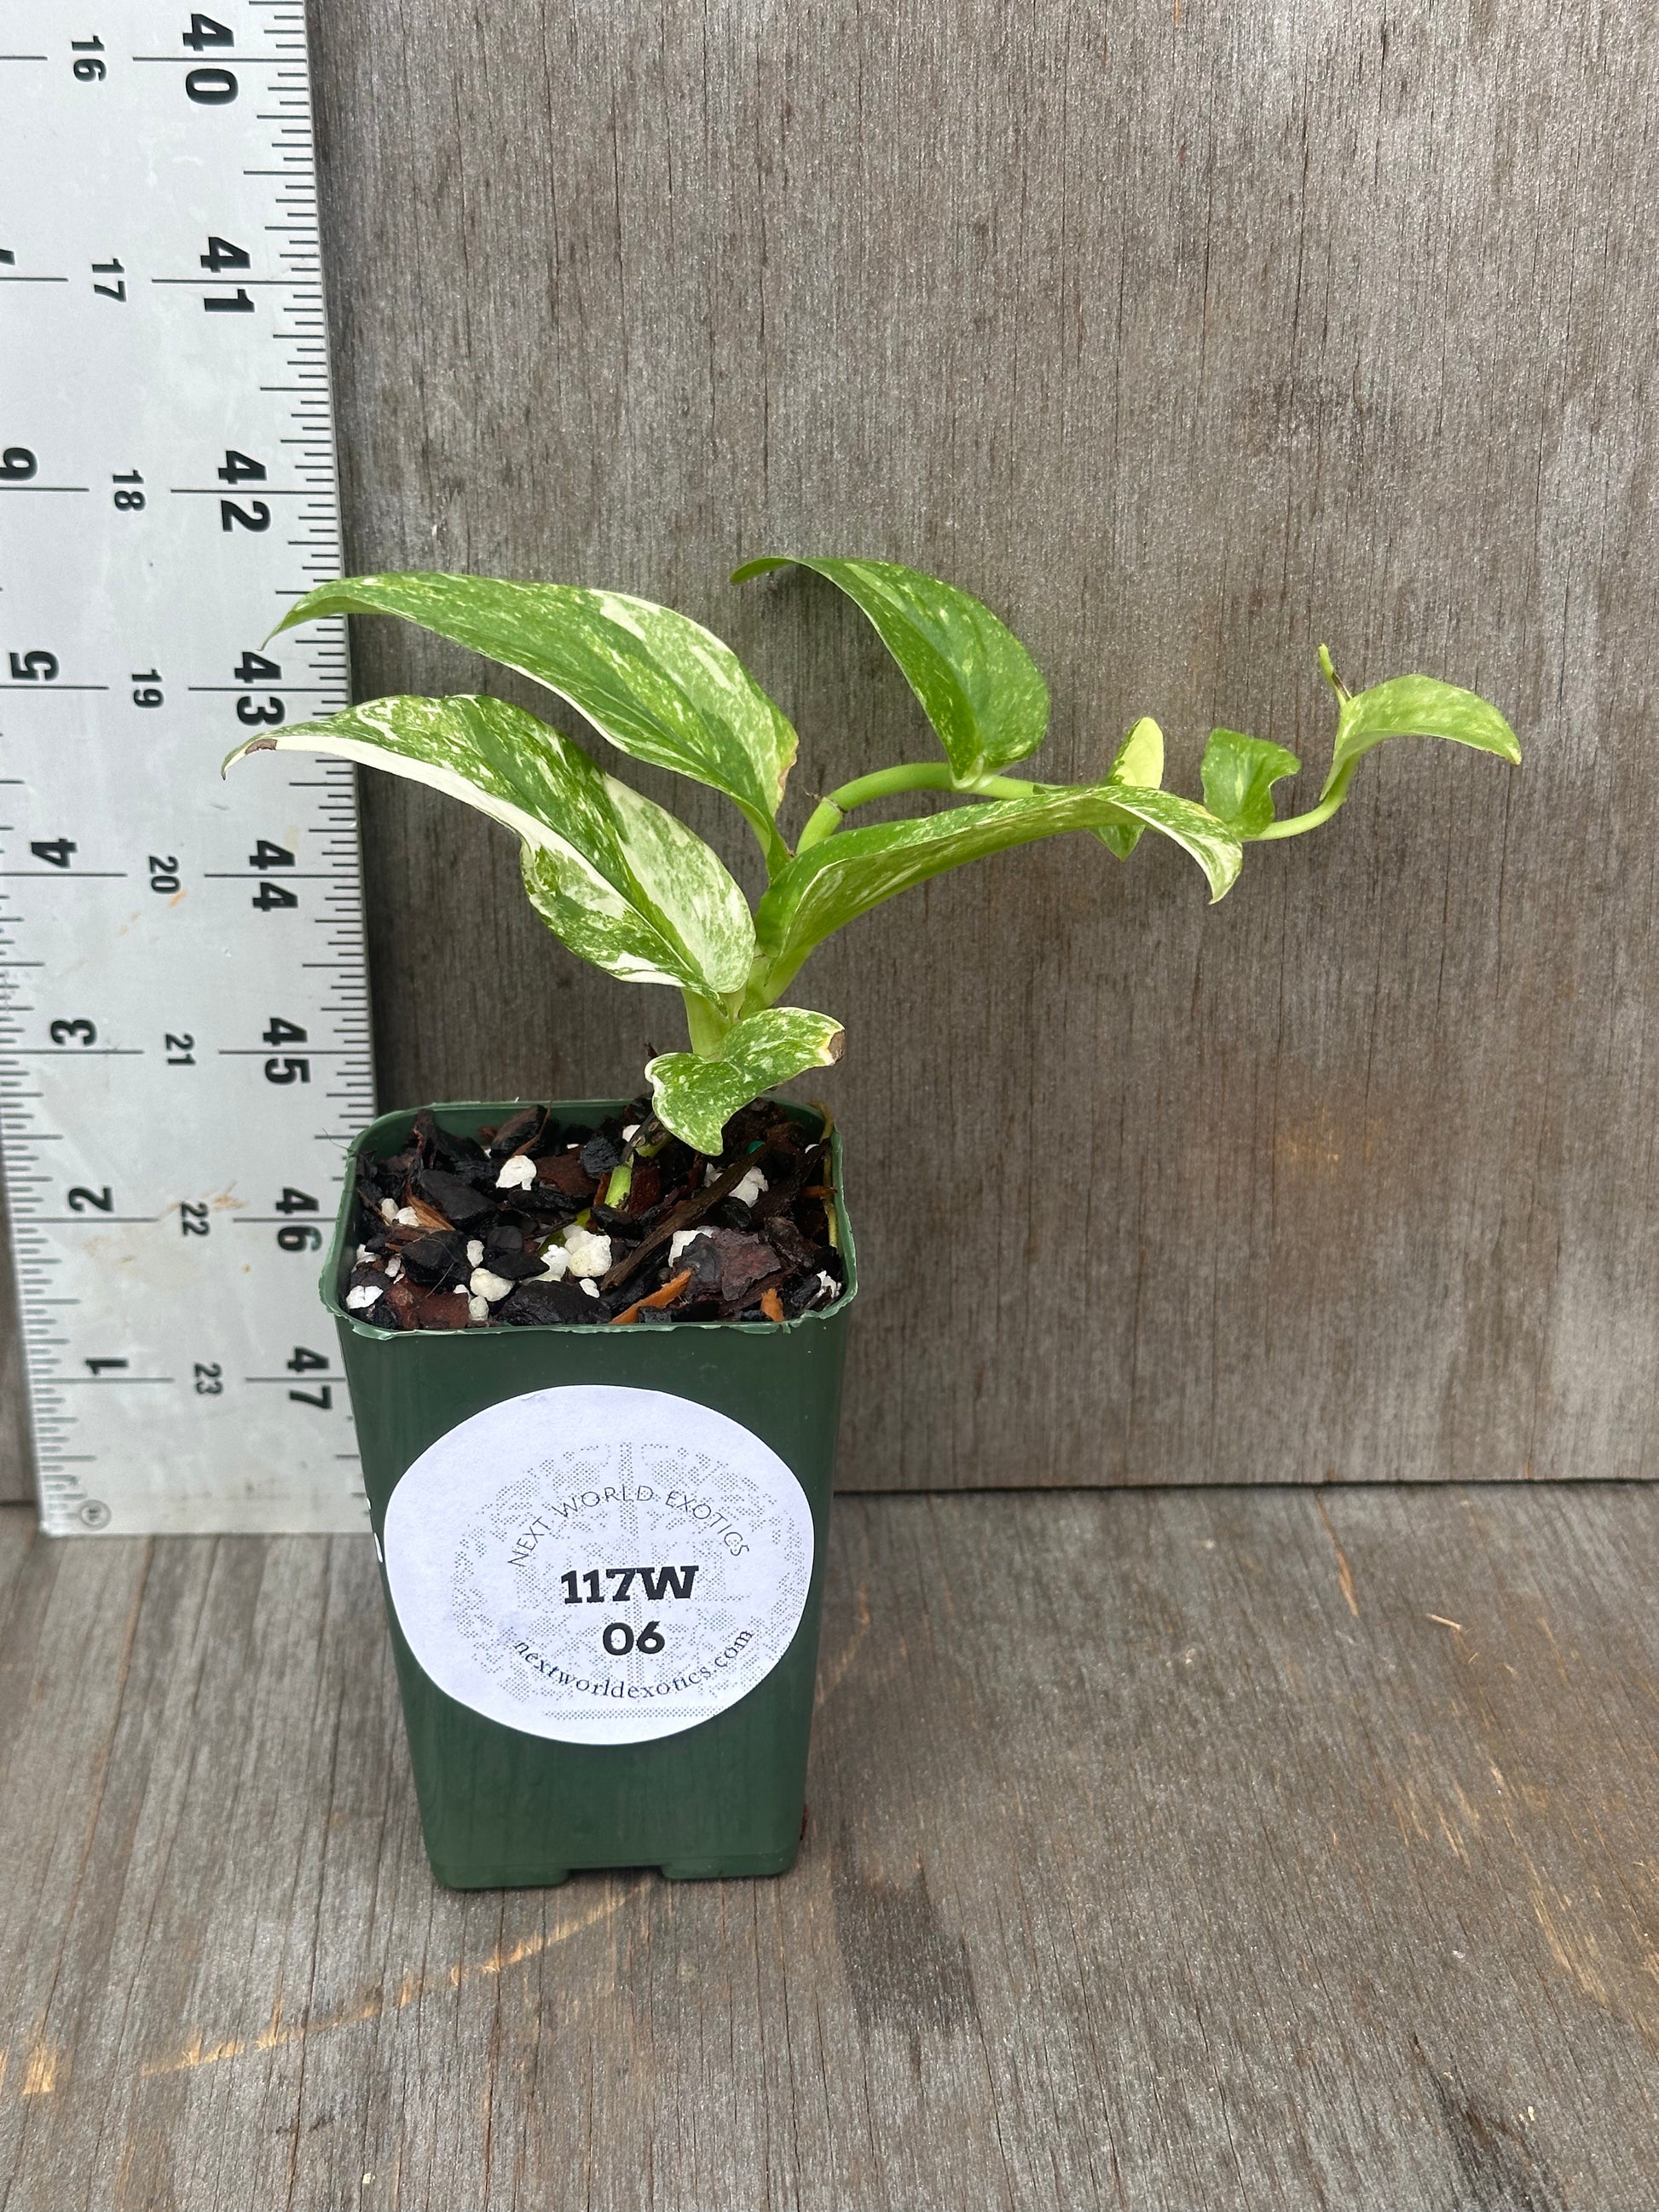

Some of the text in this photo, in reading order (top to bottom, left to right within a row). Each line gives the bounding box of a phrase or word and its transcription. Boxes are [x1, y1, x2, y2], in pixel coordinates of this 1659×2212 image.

[71, 35, 107, 82] 16
[182, 13, 239, 106] 40
[90, 257, 127, 303] 17
[199, 235, 256, 313] 41
[112, 468, 147, 512] 18
[217, 449, 271, 533] 42
[9, 650, 60, 682] 5
[130, 667, 165, 709] 19
[234, 650, 286, 727] 43
[30, 837, 78, 869] 4
[147, 855, 182, 895] 20
[249, 839, 298, 912] 44
[49, 1018, 98, 1047] 3
[164, 1033, 197, 1066] 21
[262, 1016, 311, 1086] 45
[67, 1186, 114, 1213] 2
[179, 1200, 211, 1237] 22
[275, 1187, 322, 1253] 46
[84, 1357, 130, 1376] 1
[193, 1362, 223, 1396] 23
[286, 1347, 332, 1412] 47
[507, 1483, 750, 1568] NEXT WORLD EXOTICS
[560, 1564, 700, 1604] 117W
[601, 1620, 666, 1656] 06
[512, 1629, 754, 1699] nextworldexotics.com
